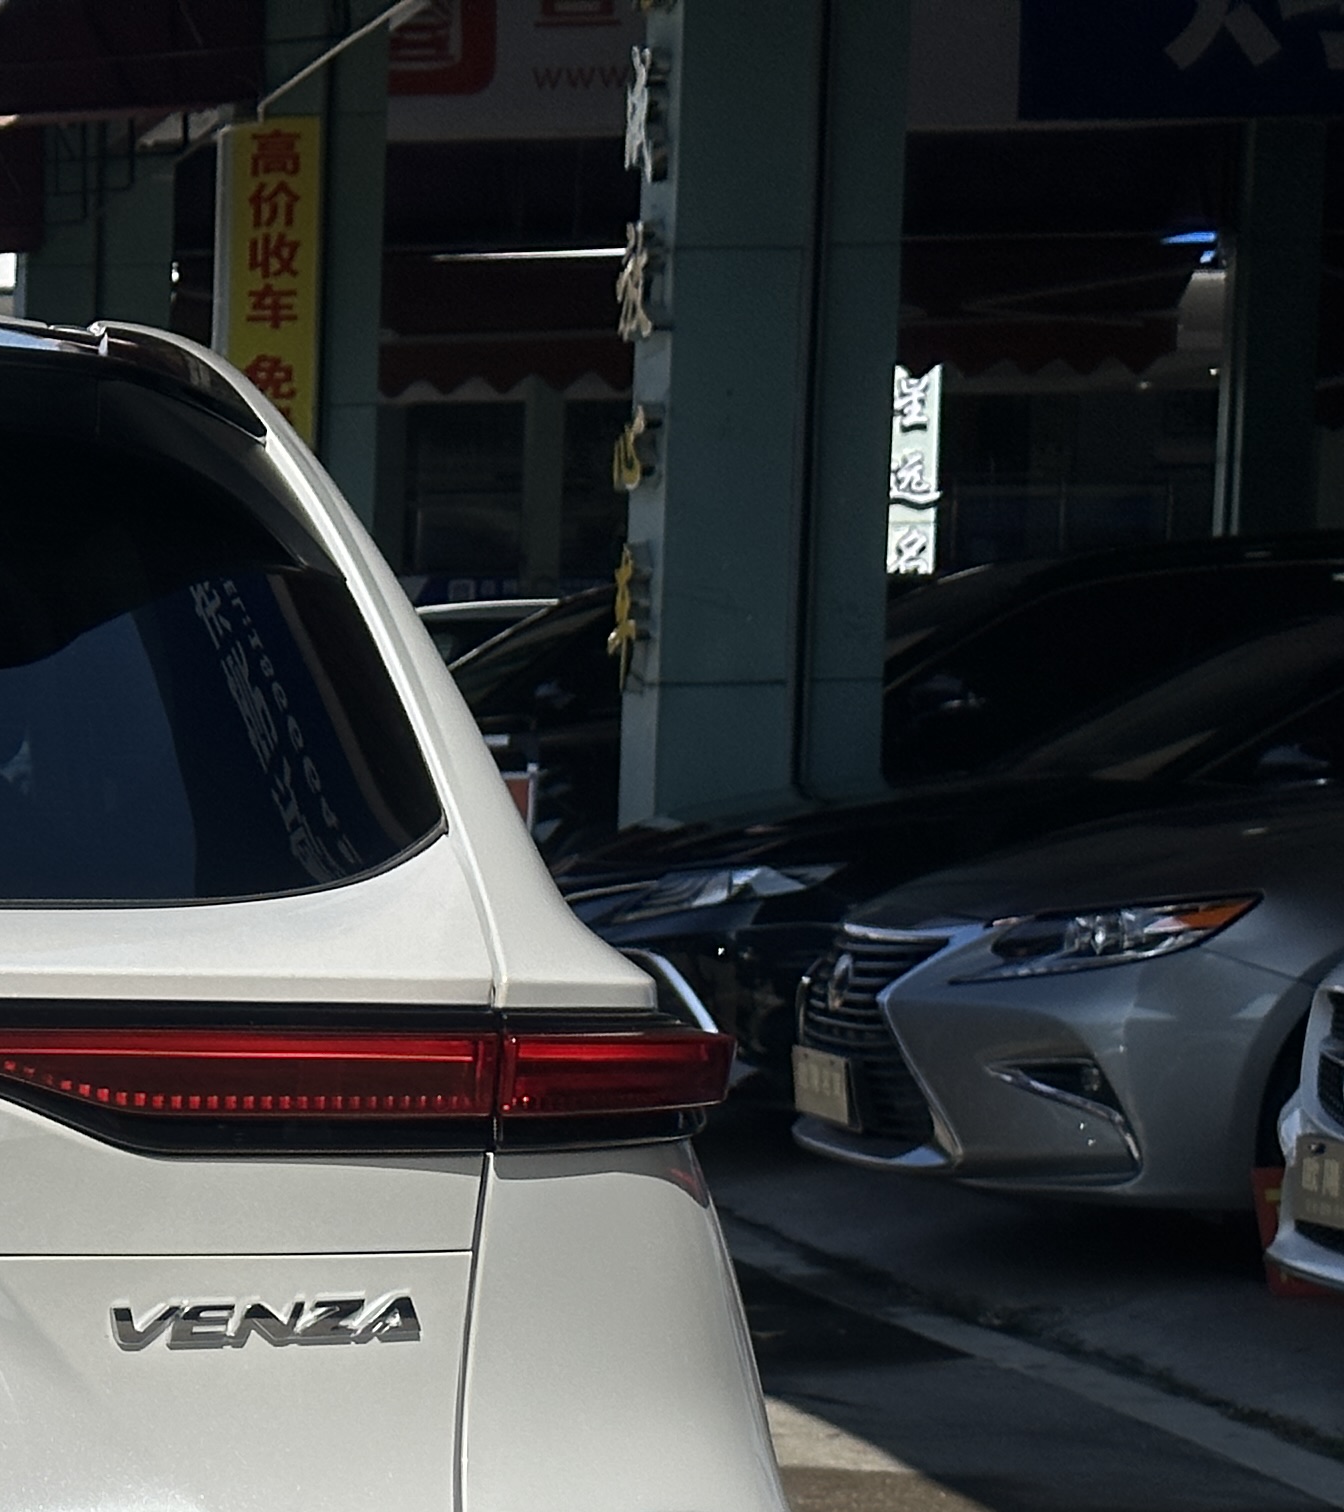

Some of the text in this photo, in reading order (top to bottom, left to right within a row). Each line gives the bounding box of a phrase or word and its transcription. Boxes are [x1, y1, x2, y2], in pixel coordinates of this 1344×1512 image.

[244, 129, 301, 420] 高价收车 免
[110, 1287, 423, 1352] VENZA
